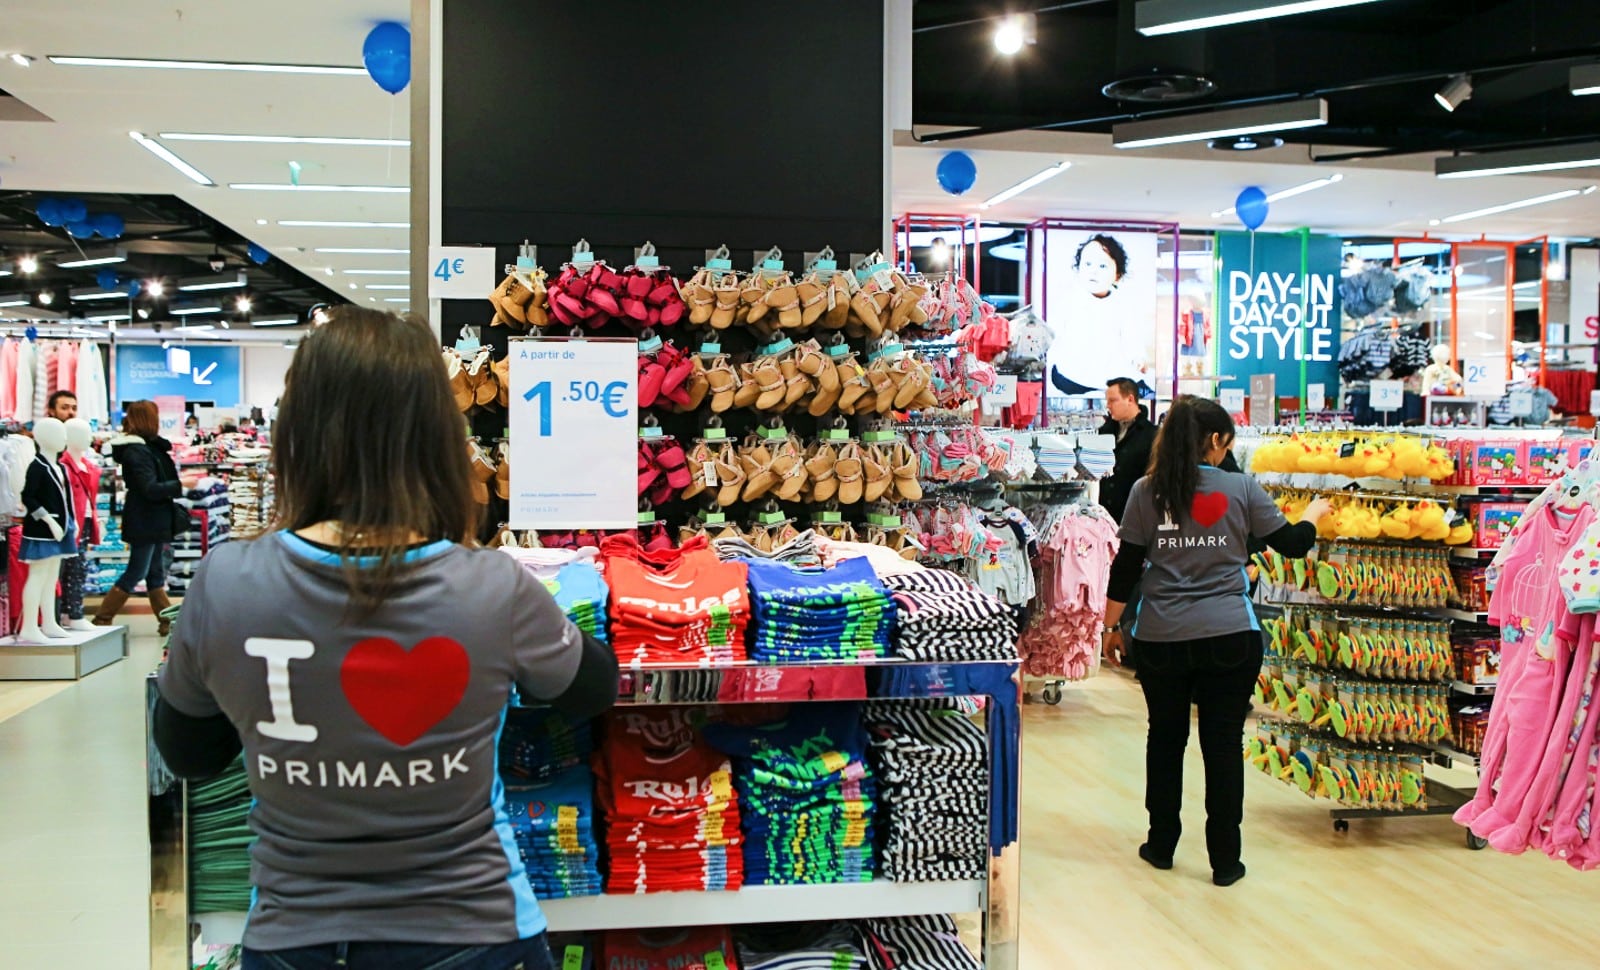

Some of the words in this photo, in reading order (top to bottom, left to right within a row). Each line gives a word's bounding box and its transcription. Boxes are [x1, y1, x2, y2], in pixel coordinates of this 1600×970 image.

[434, 258, 465, 282] 4€
[1229, 270, 1334, 305] DAY-IN
[1229, 301, 1333, 328] DAY-OUT
[530, 350, 560, 361] partir
[562, 349, 576, 360] de
[1229, 325, 1332, 361] STYLE
[1469, 366, 1487, 383] 2€
[1157, 535, 1228, 549] PRIMARK
[244, 637, 319, 743] I
[257, 747, 470, 788] PRIMARK
